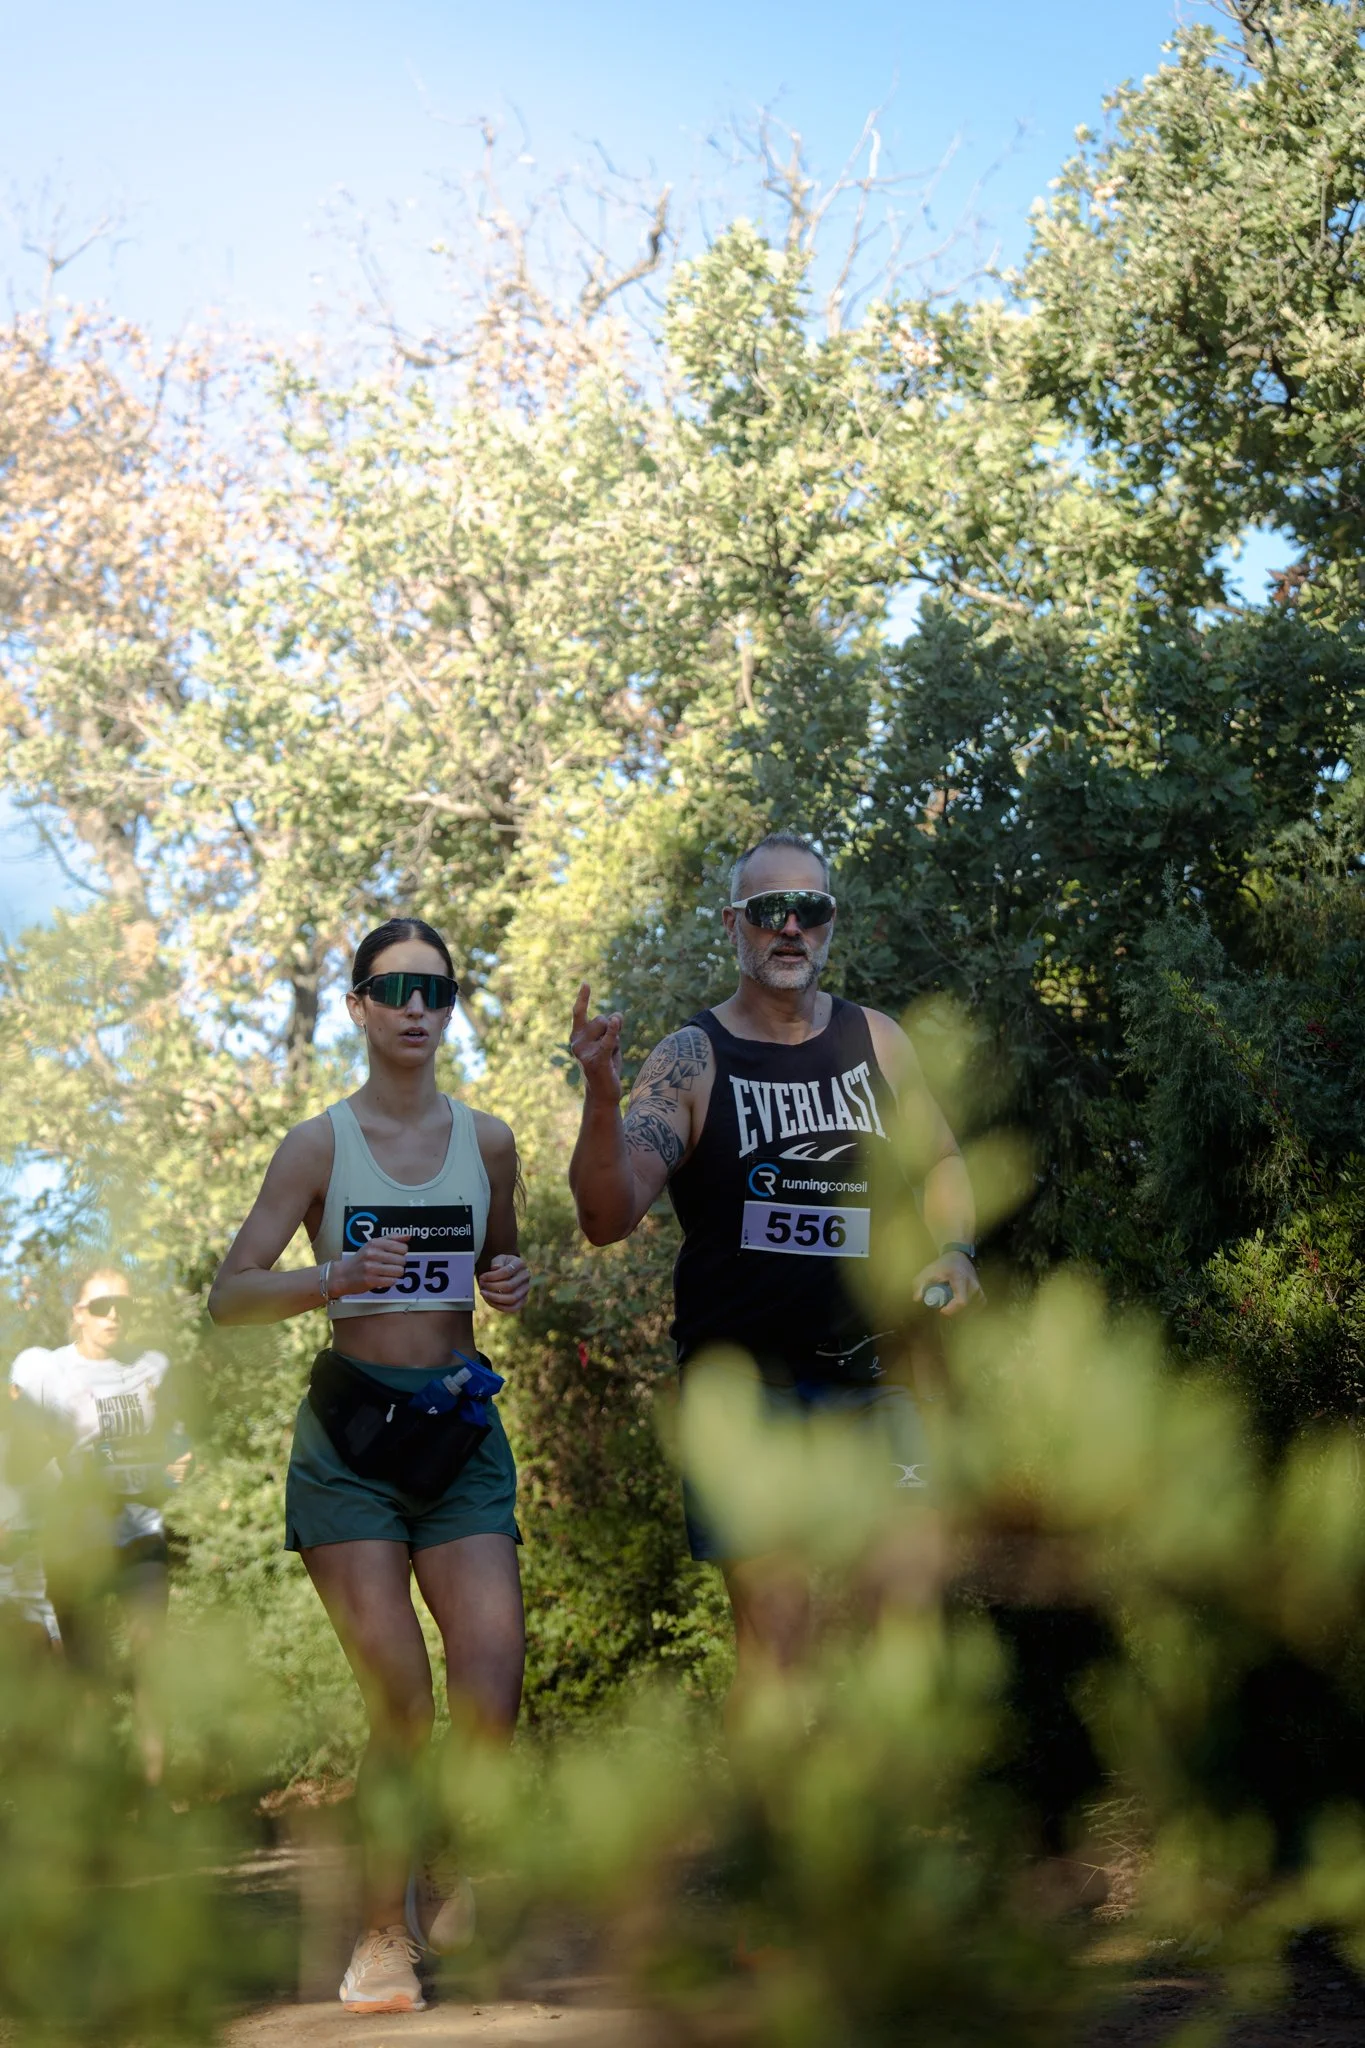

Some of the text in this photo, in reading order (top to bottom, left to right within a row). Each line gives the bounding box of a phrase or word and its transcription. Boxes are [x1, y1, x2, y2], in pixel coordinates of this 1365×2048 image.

[729, 1061, 887, 1159] EVERLAST
[782, 1178, 868, 1194] runningconseil
[381, 1224, 471, 1239] runningconseil
[765, 1211, 847, 1248] 556
[369, 1261, 450, 1294] 55
